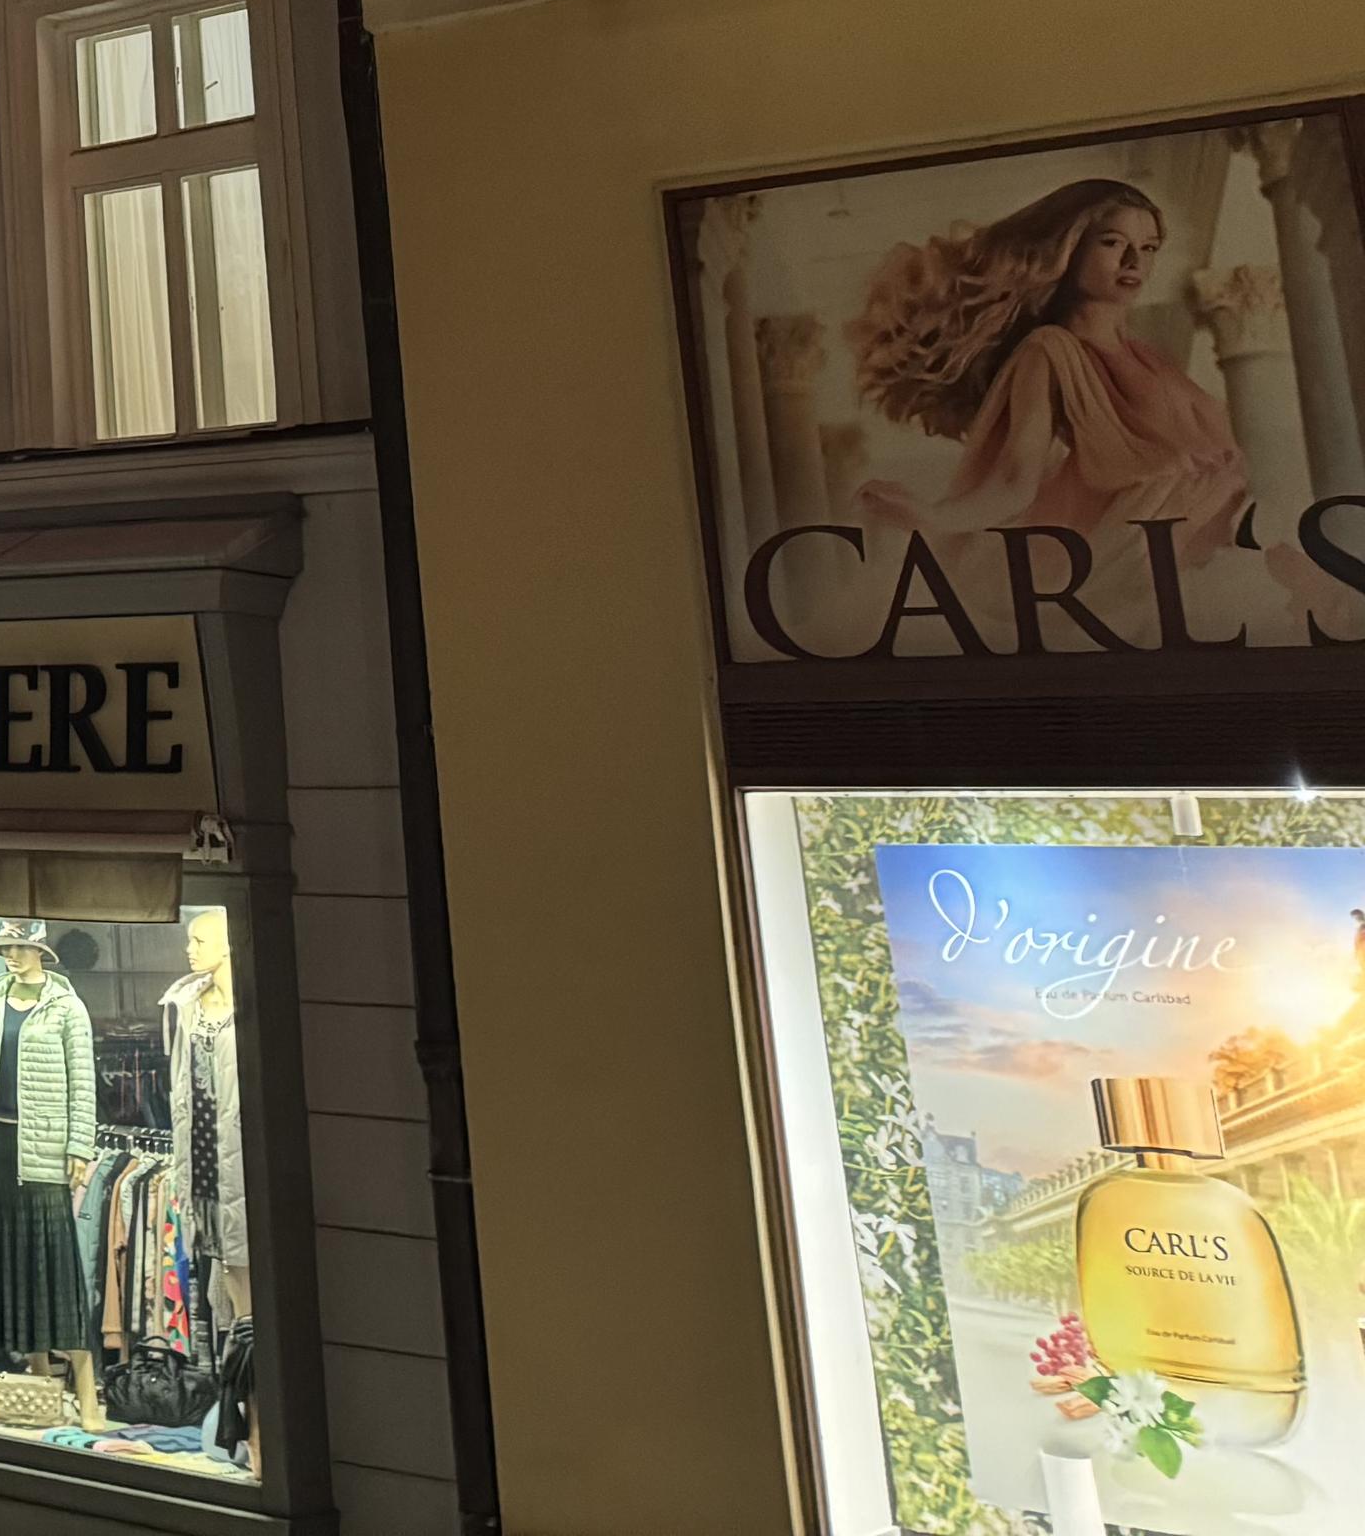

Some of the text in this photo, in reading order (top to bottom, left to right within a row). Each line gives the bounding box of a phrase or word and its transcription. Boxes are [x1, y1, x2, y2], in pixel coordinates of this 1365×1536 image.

[928, 869, 1242, 1020] d'origine
[1132, 990, 1191, 1005] Carlsbad
[1125, 1265, 1237, 1286] SOURCE DE LA VIE
